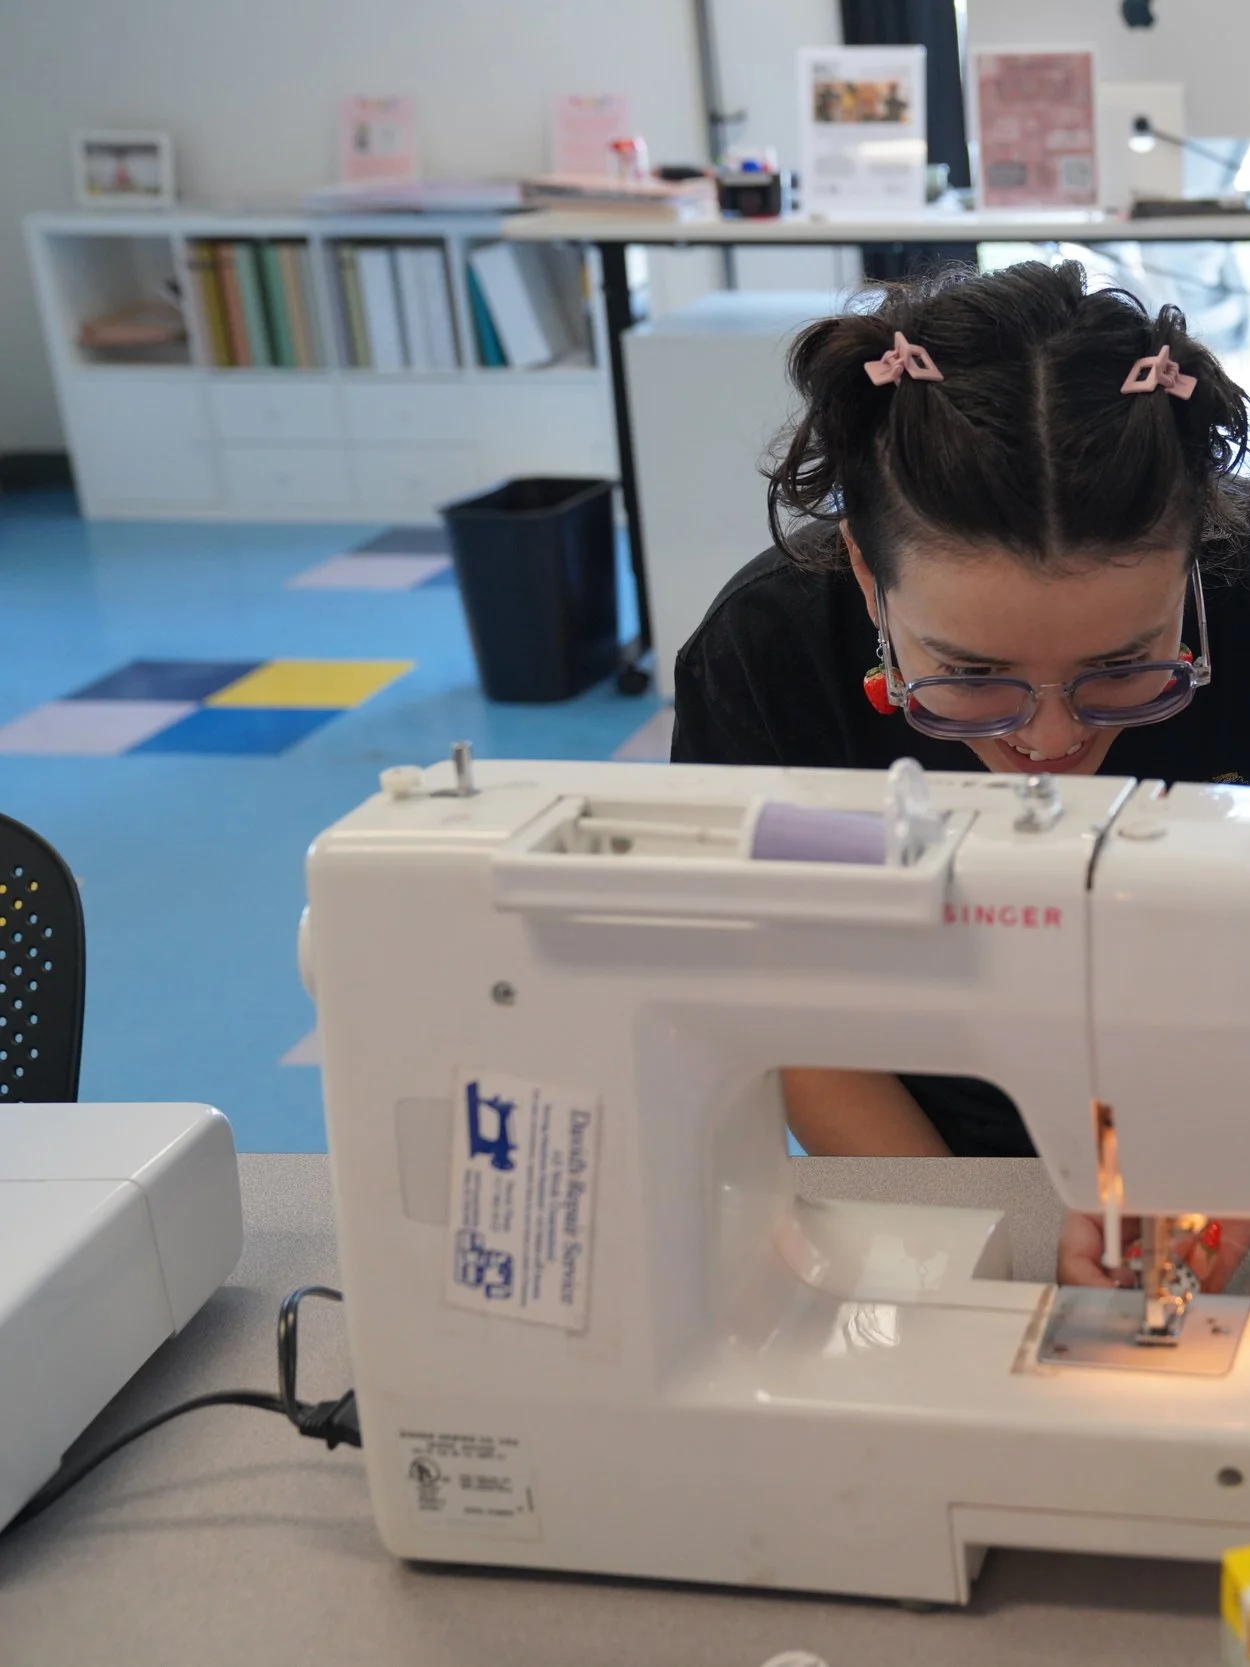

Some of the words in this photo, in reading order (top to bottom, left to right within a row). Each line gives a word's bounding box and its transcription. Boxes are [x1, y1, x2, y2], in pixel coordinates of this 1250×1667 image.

[942, 903, 1063, 929] SINGER
[560, 1179, 588, 1238] Repair
[560, 1242, 583, 1306] Service
